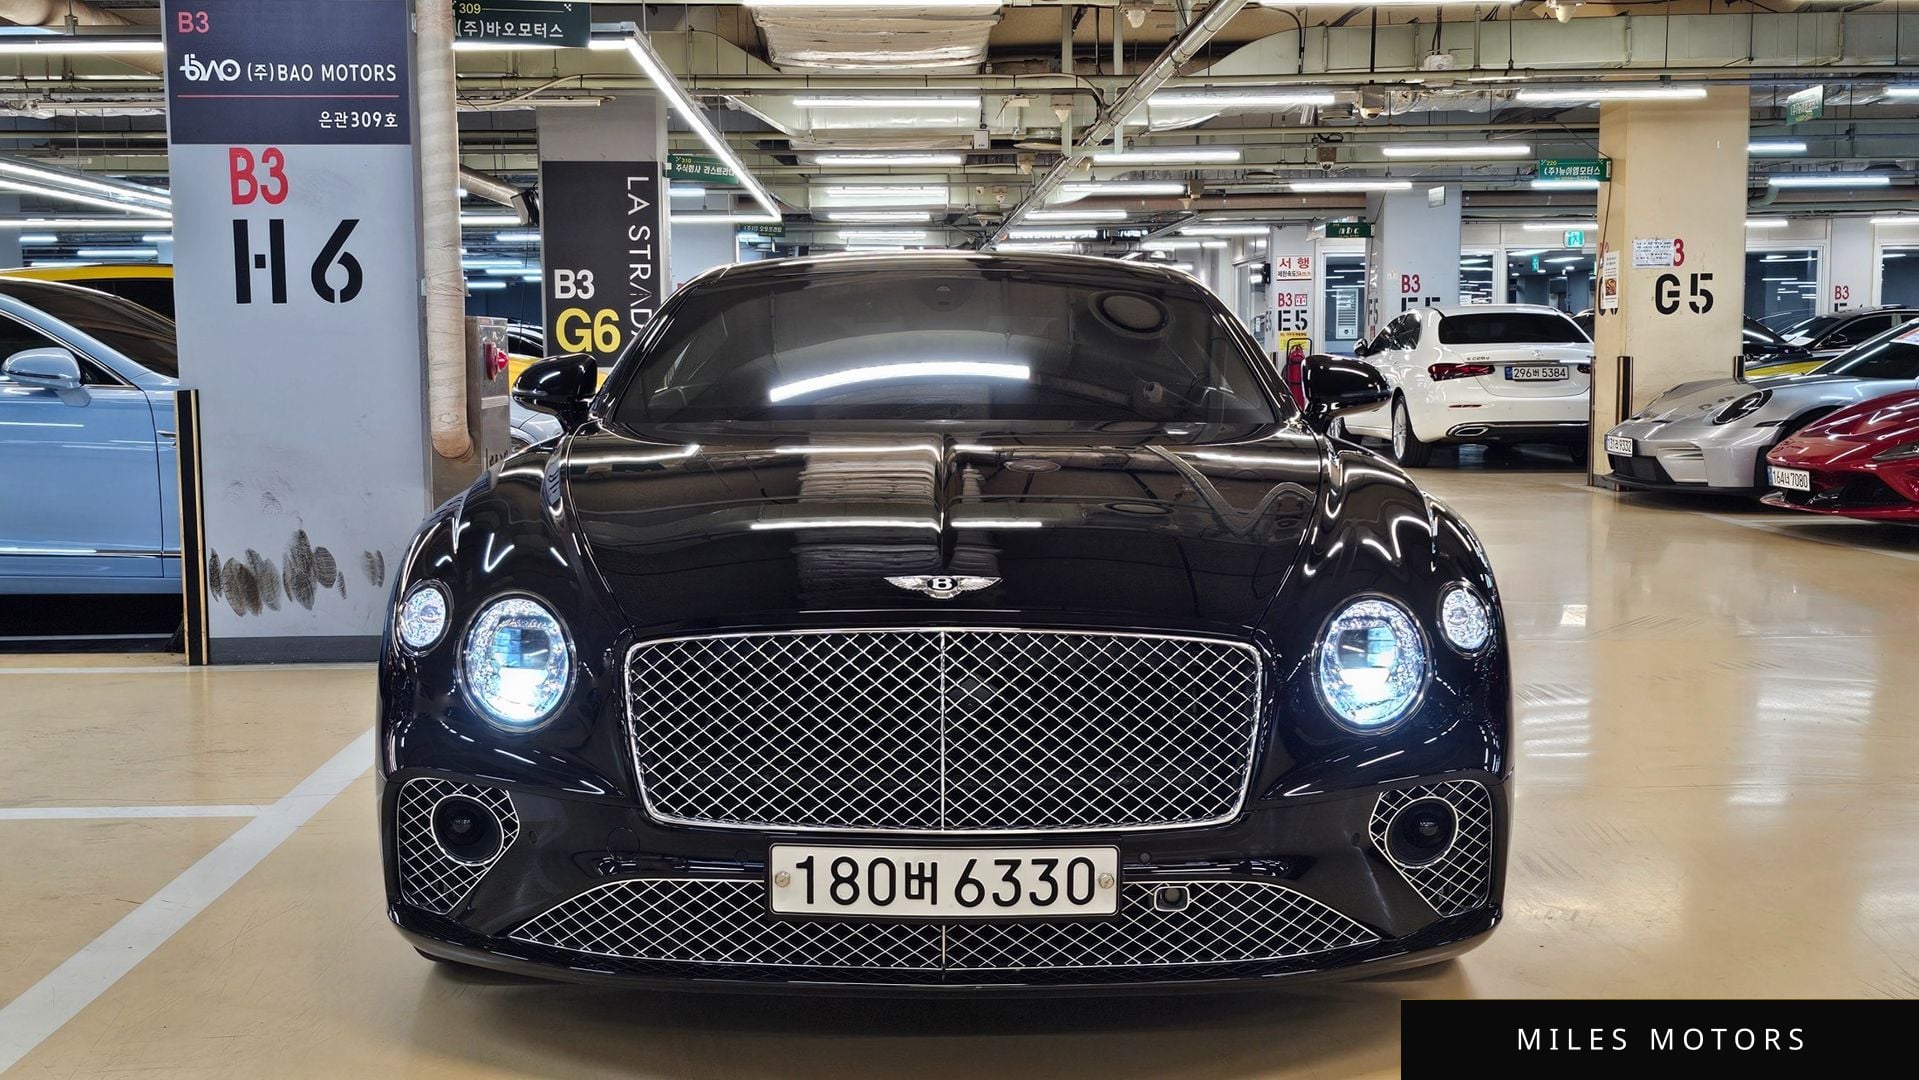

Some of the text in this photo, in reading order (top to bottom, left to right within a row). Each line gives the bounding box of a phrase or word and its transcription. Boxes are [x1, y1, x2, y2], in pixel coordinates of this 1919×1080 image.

[459, 3, 481, 14] 309
[178, 11, 210, 33] B3
[457, 20, 564, 38] (주)바오모터스
[322, 64, 397, 82] MOTORS
[319, 111, 398, 129] 은관309호
[229, 147, 288, 205] B3
[627, 176, 653, 337] LA STRAD
[554, 269, 595, 299] B3
[1401, 274, 1421, 294] B3
[1655, 273, 1714, 315] G5
[1835, 285, 1849, 300] B3
[1278, 293, 1292, 307] B3
[556, 308, 621, 353] G6
[1278, 310, 1308, 331] E5
[1541, 368, 1566, 378] 5384
[954, 857, 1096, 907] 6330
